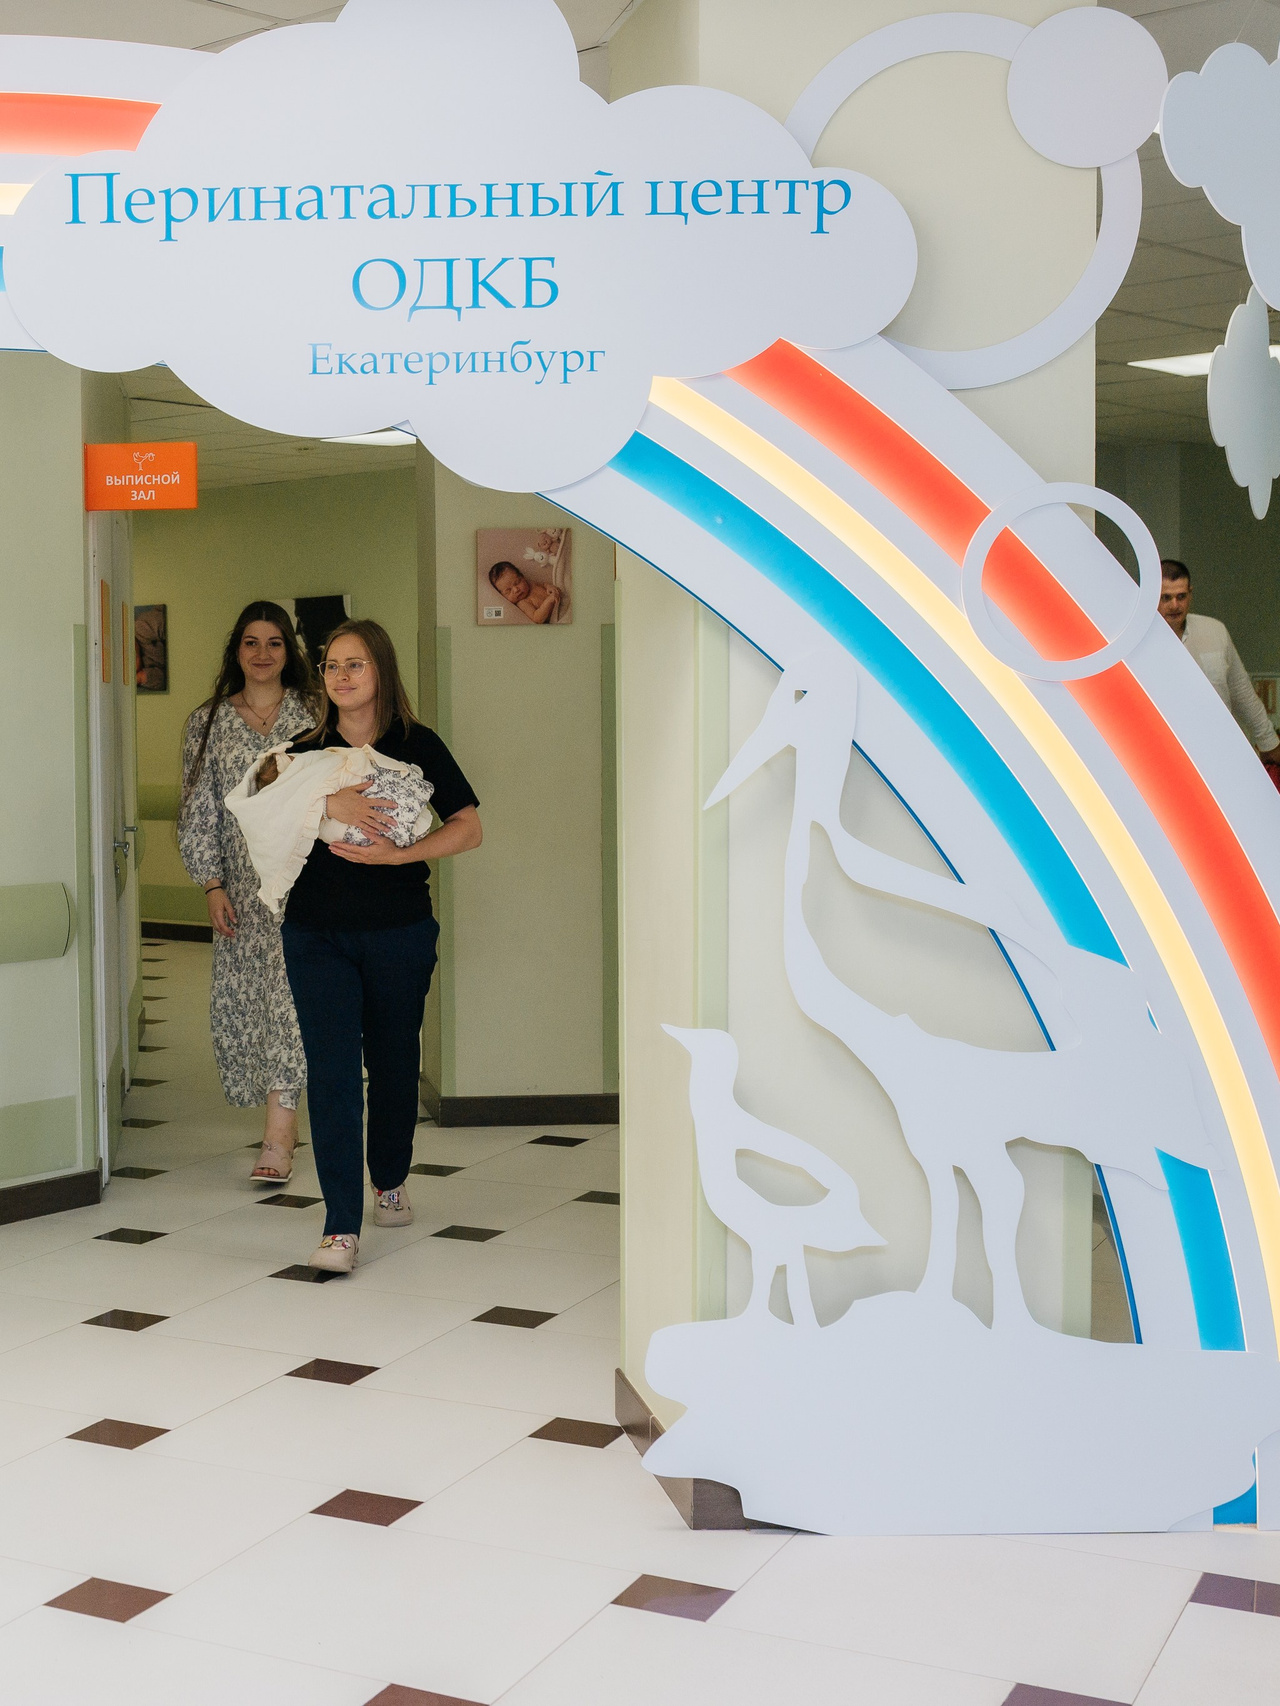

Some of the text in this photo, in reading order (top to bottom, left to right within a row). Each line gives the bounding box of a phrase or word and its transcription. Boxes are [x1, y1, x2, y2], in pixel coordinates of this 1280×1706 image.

[63, 169, 853, 242] Перинатальный центр
[350, 255, 561, 322] ОДКБ
[307, 339, 606, 386] Екатеринбург
[105, 471, 180, 486] ВЫПИСНОЙ
[130, 490, 156, 501] ЗАЛ
